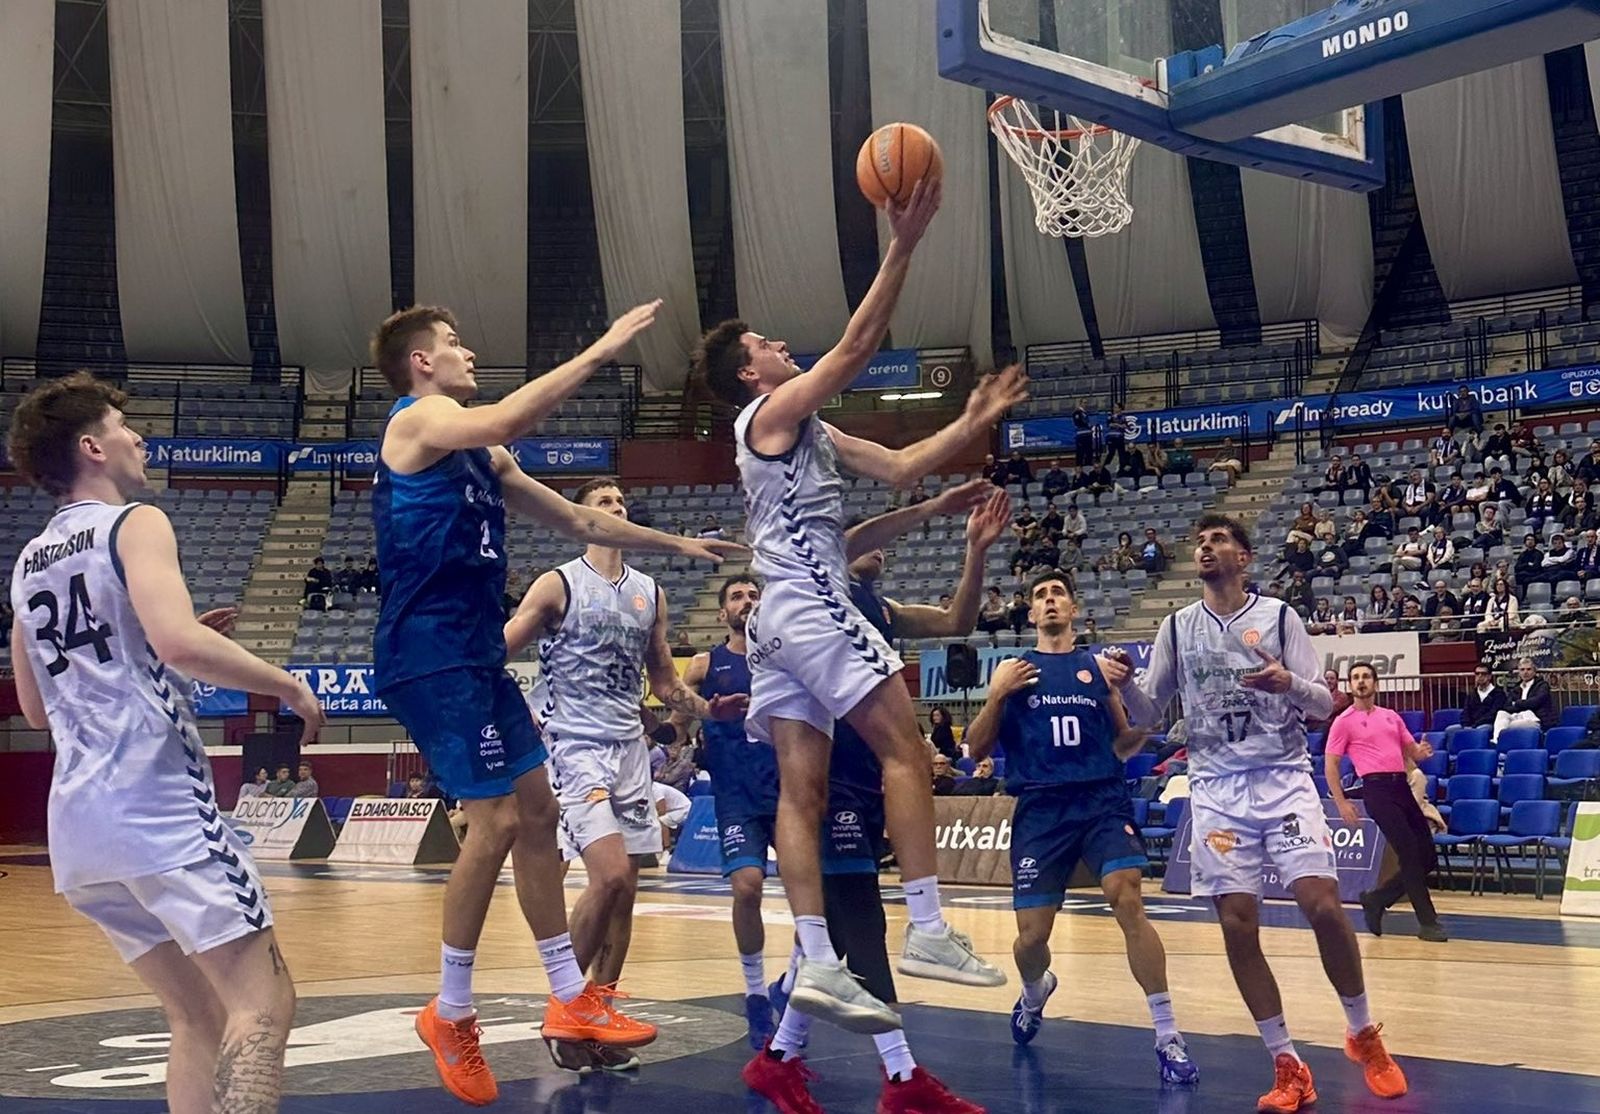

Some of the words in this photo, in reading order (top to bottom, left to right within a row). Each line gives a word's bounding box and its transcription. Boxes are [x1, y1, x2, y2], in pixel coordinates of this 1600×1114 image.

[1322, 11, 1409, 58] MONDO
[868, 364, 908, 375] arena
[1304, 400, 1394, 421] Ineready
[157, 445, 262, 463] Naturklima
[312, 451, 379, 464] Inverea
[28, 573, 113, 677] 34
[1042, 695, 1097, 707] Naturklima
[1050, 716, 1081, 747] 10
[1220, 711, 1251, 742] 17
[351, 803, 364, 816] EL
[362, 803, 399, 816] DIARIO
[398, 803, 432, 816] VASCO
